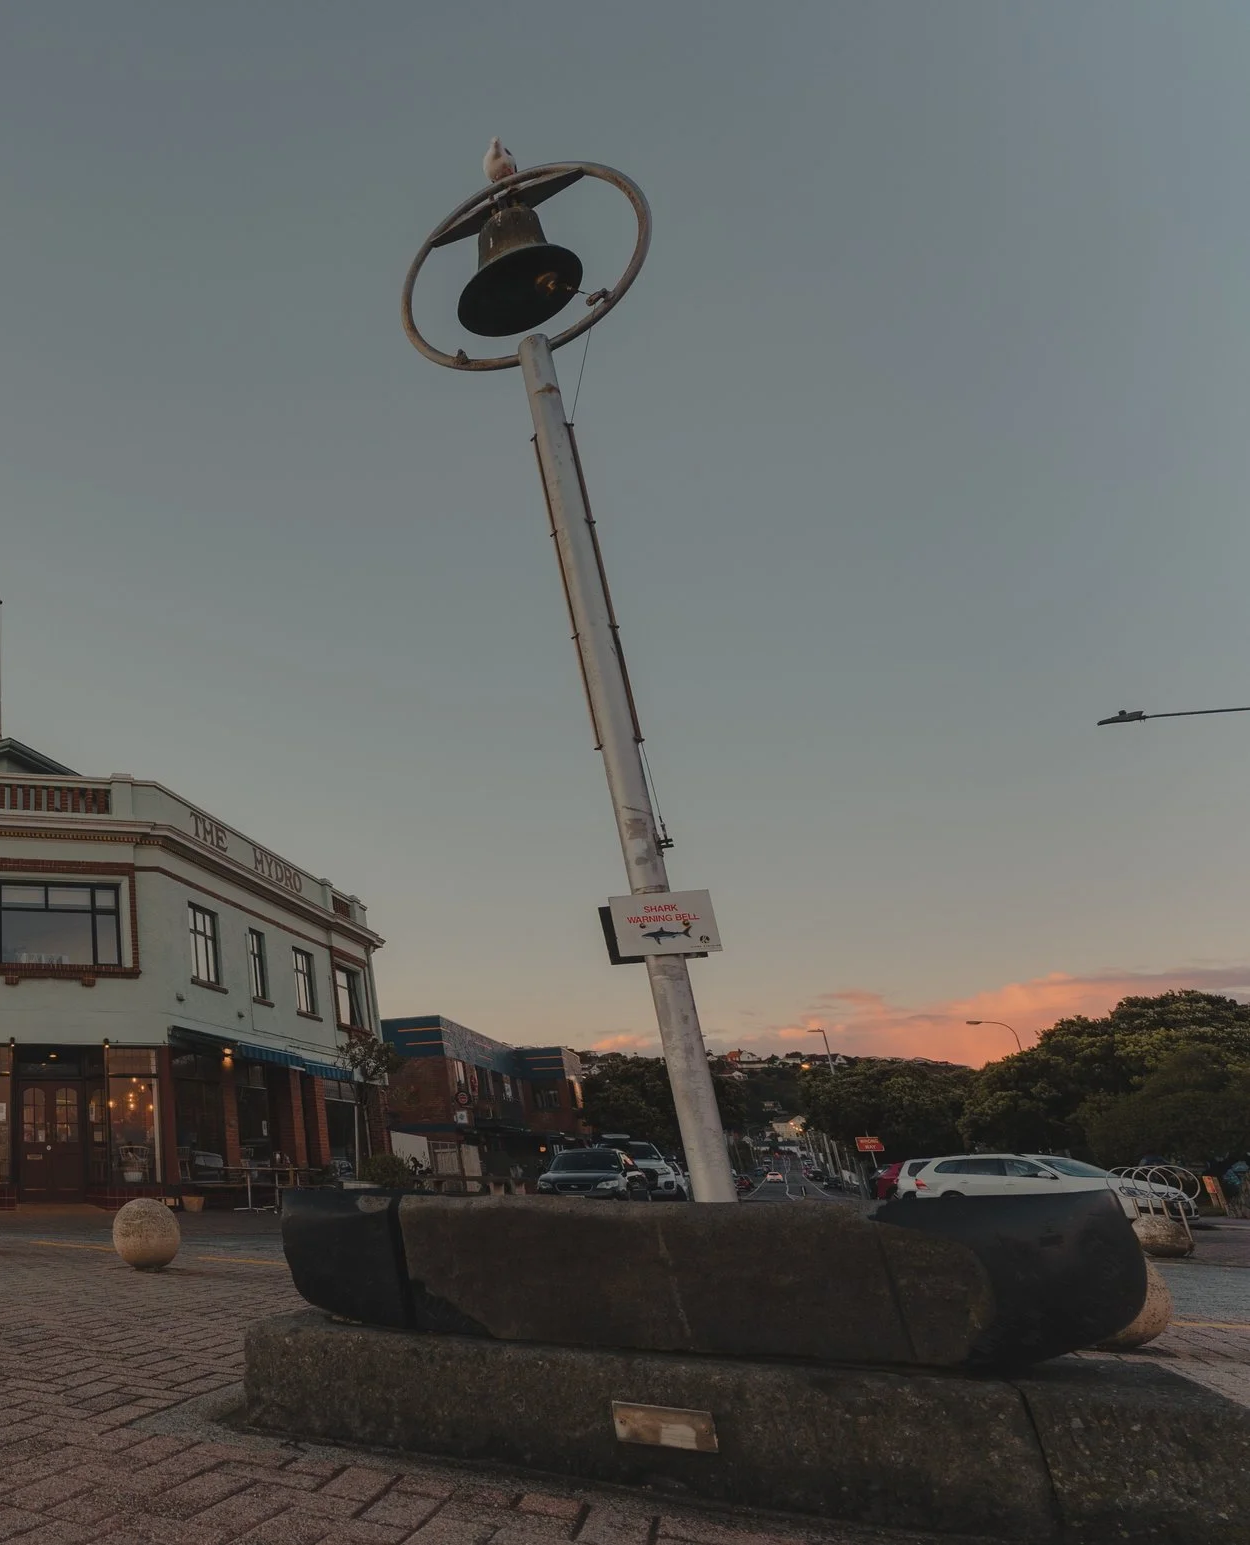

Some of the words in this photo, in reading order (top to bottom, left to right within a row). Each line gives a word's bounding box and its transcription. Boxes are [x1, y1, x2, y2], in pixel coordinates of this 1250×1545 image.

[190, 811, 229, 853] THE
[252, 847, 303, 893] HYDRO
[643, 904, 678, 913] SHARK
[627, 914, 673, 924] WARNING
[675, 913, 700, 921] BELL
